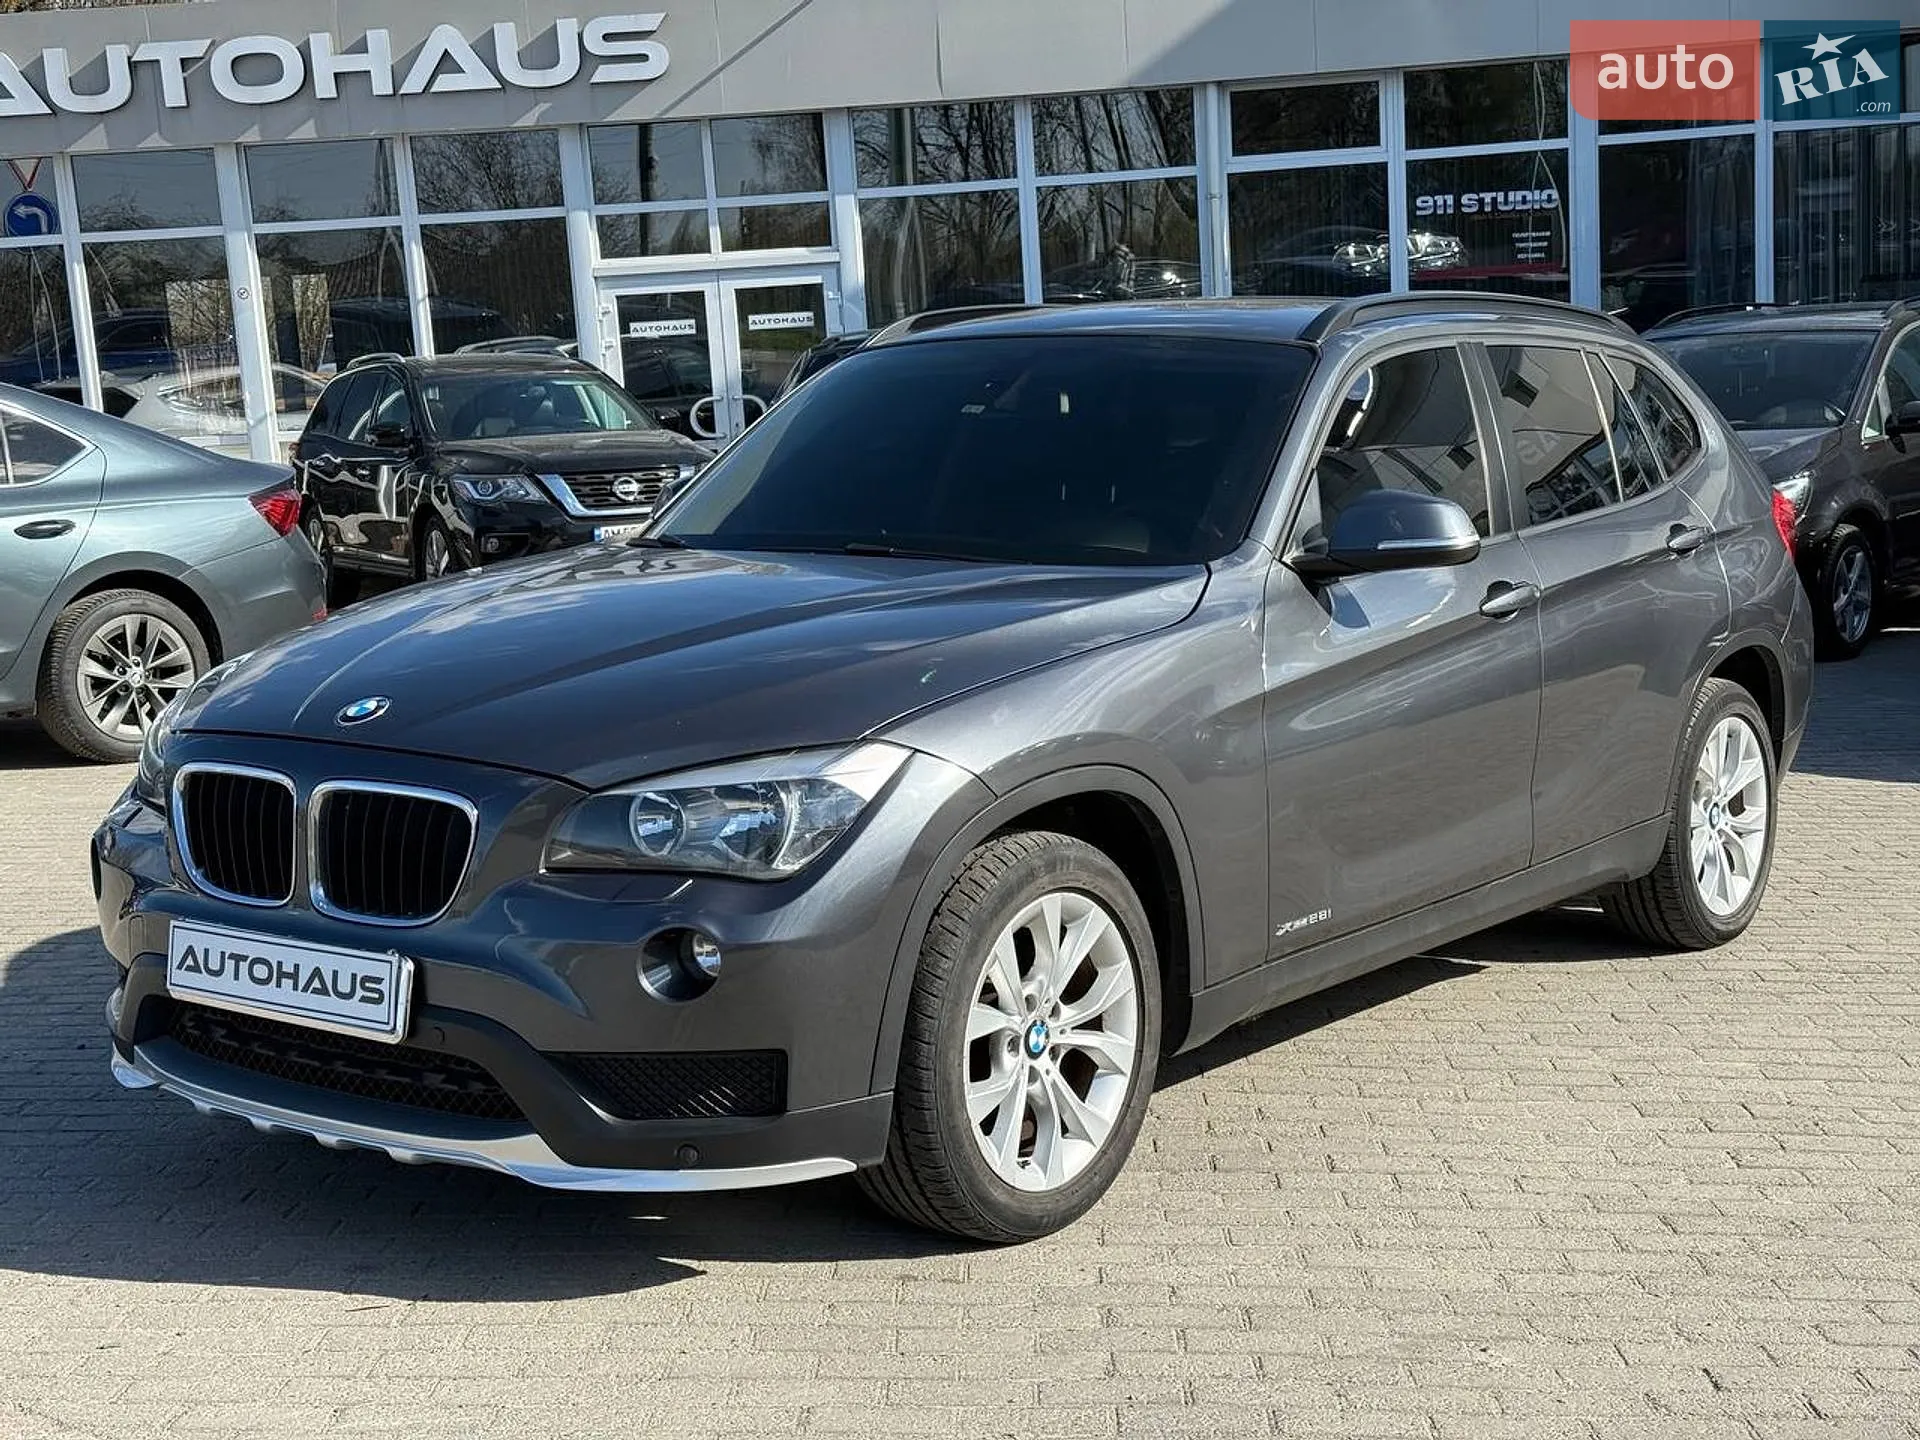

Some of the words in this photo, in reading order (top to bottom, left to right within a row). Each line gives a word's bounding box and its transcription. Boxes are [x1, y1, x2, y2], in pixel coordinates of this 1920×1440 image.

[1415, 194, 1454, 216] 911
[1461, 188, 1560, 213] STUDIO
[631, 323, 695, 334] AUTOHAUS
[750, 315, 814, 327] AUTOHAUS
[175, 944, 386, 1005] AUTOHAUS
